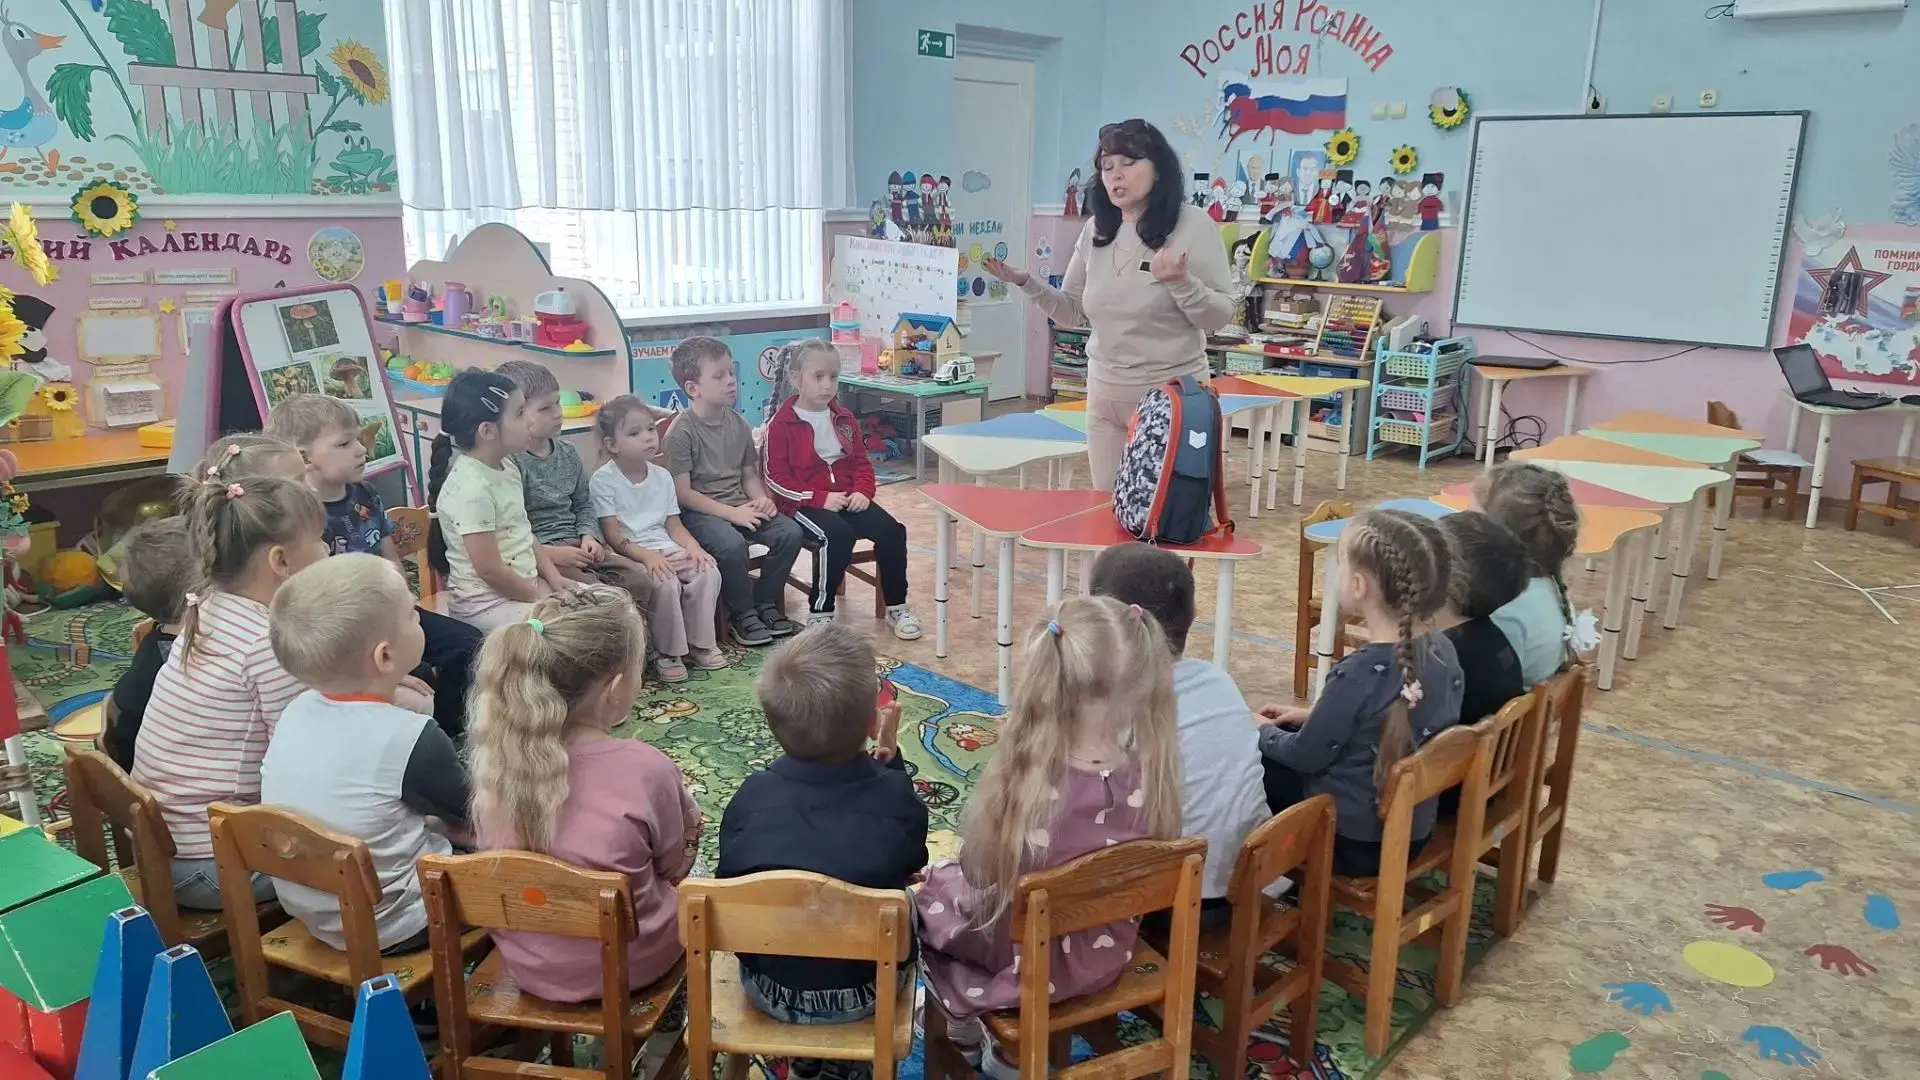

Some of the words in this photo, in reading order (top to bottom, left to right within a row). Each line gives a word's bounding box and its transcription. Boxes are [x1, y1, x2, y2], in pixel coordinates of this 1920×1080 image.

[1180, 0, 1284, 78] РОССИЯ
[1294, 0, 1394, 73] РОДИНА
[1251, 33, 1312, 77] МОЯ
[952, 221, 964, 235] НИ
[969, 219, 1003, 235] НЕДЕЛИ
[0, 234, 92, 260] АИЙ
[108, 231, 293, 265] КАЛЕНДАРЬ
[631, 346, 669, 358] ЗУЧАЕМ
